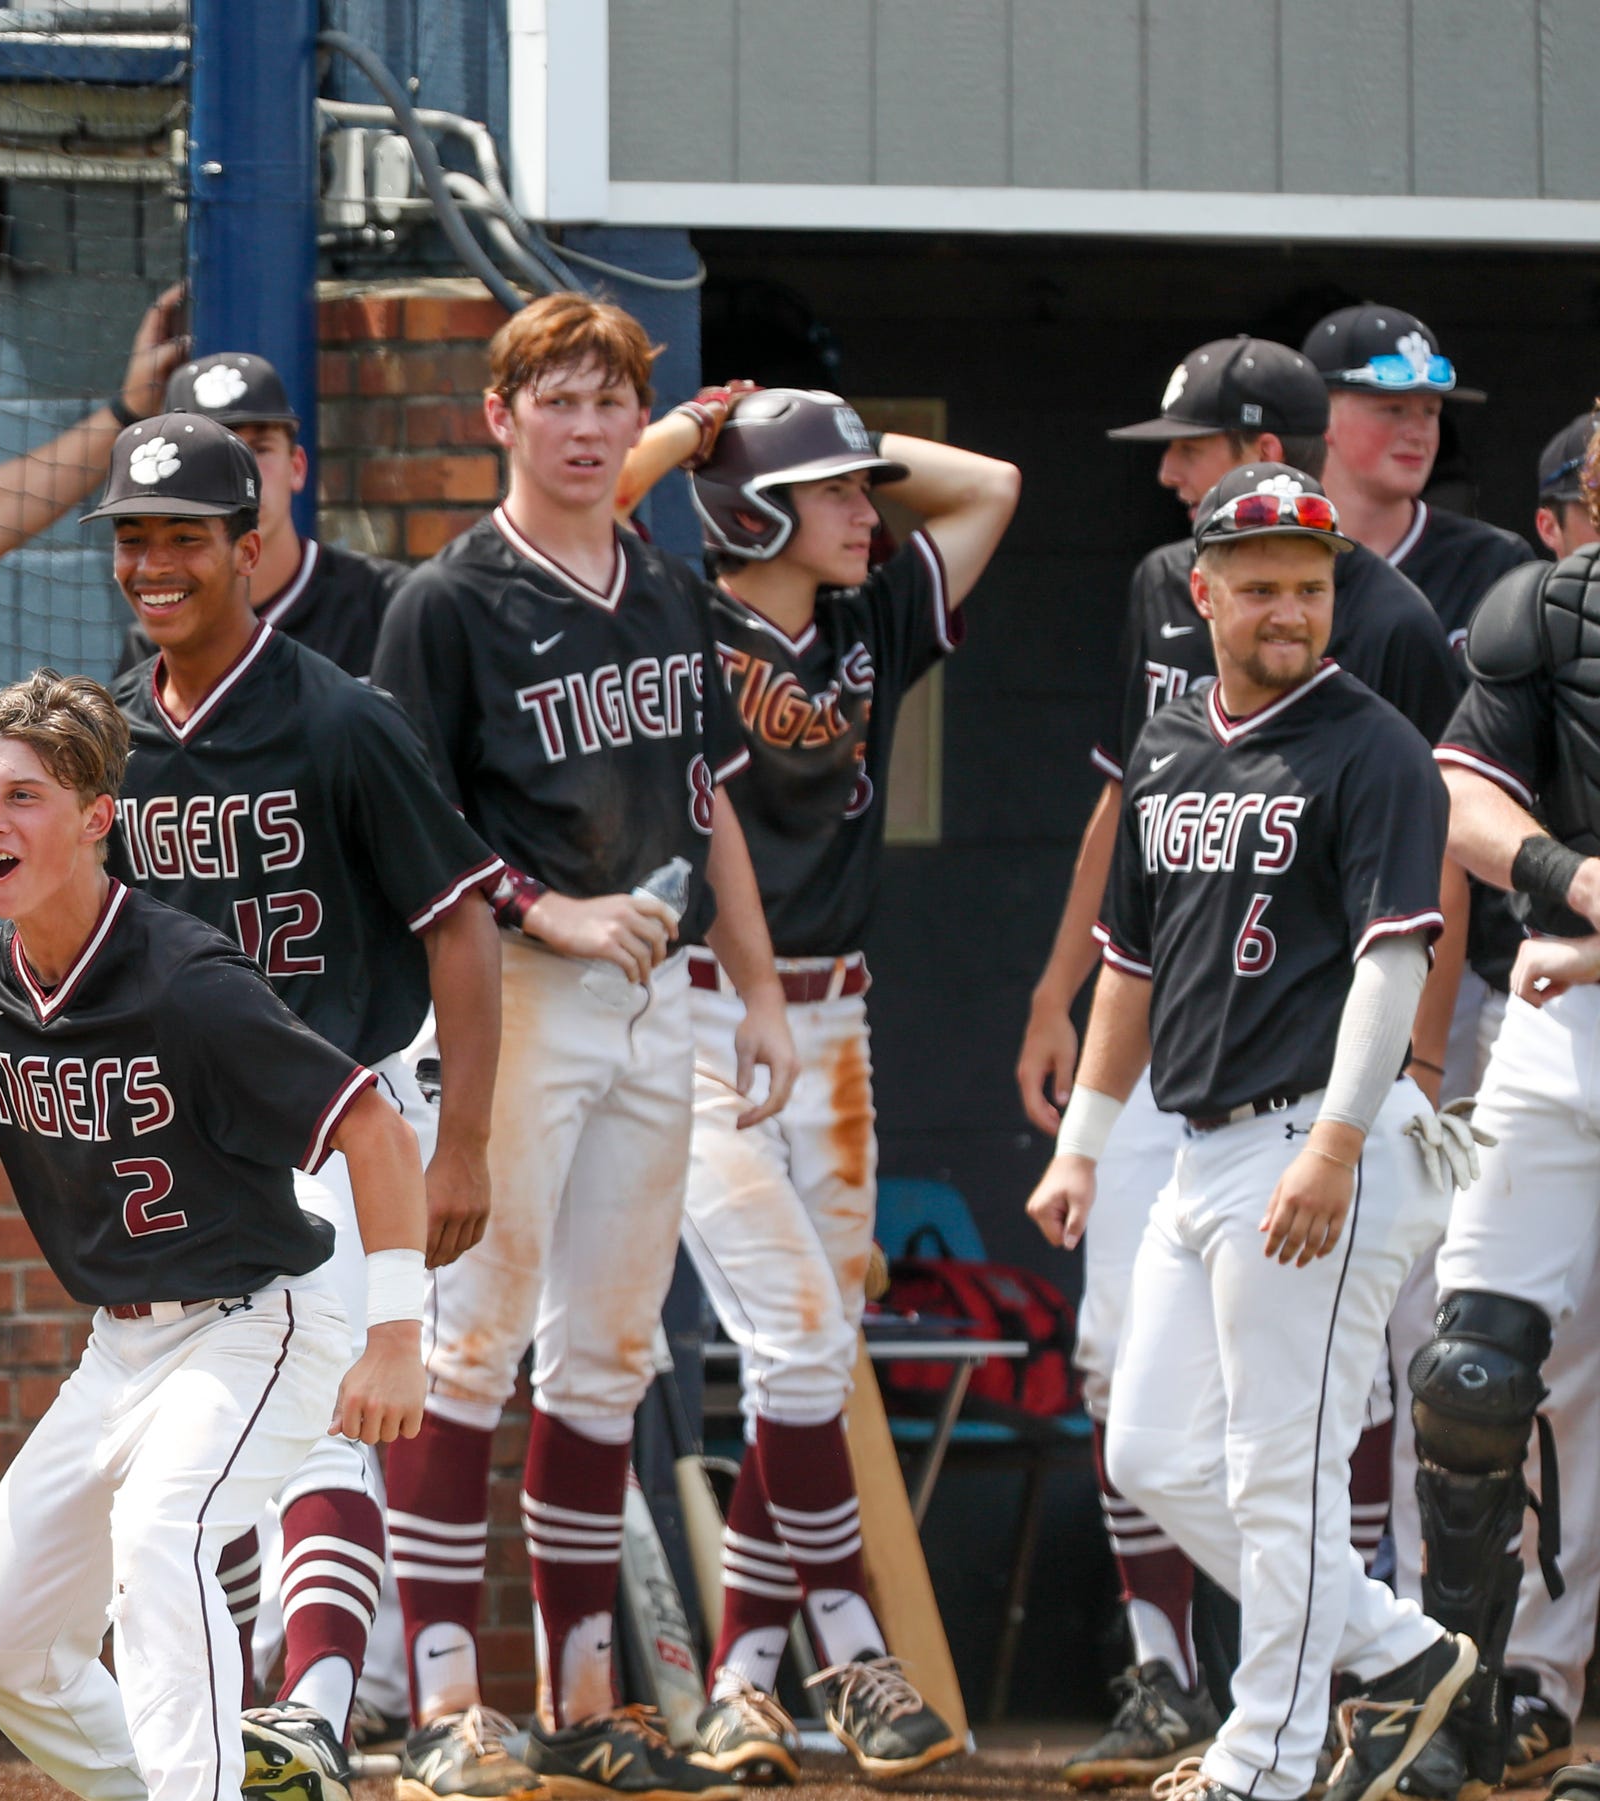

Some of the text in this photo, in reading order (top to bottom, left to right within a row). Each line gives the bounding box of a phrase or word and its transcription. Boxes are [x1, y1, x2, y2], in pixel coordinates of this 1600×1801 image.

[234, 889, 325, 976] 12
[1233, 893, 1276, 977] 6
[112, 1157, 188, 1237] 2
